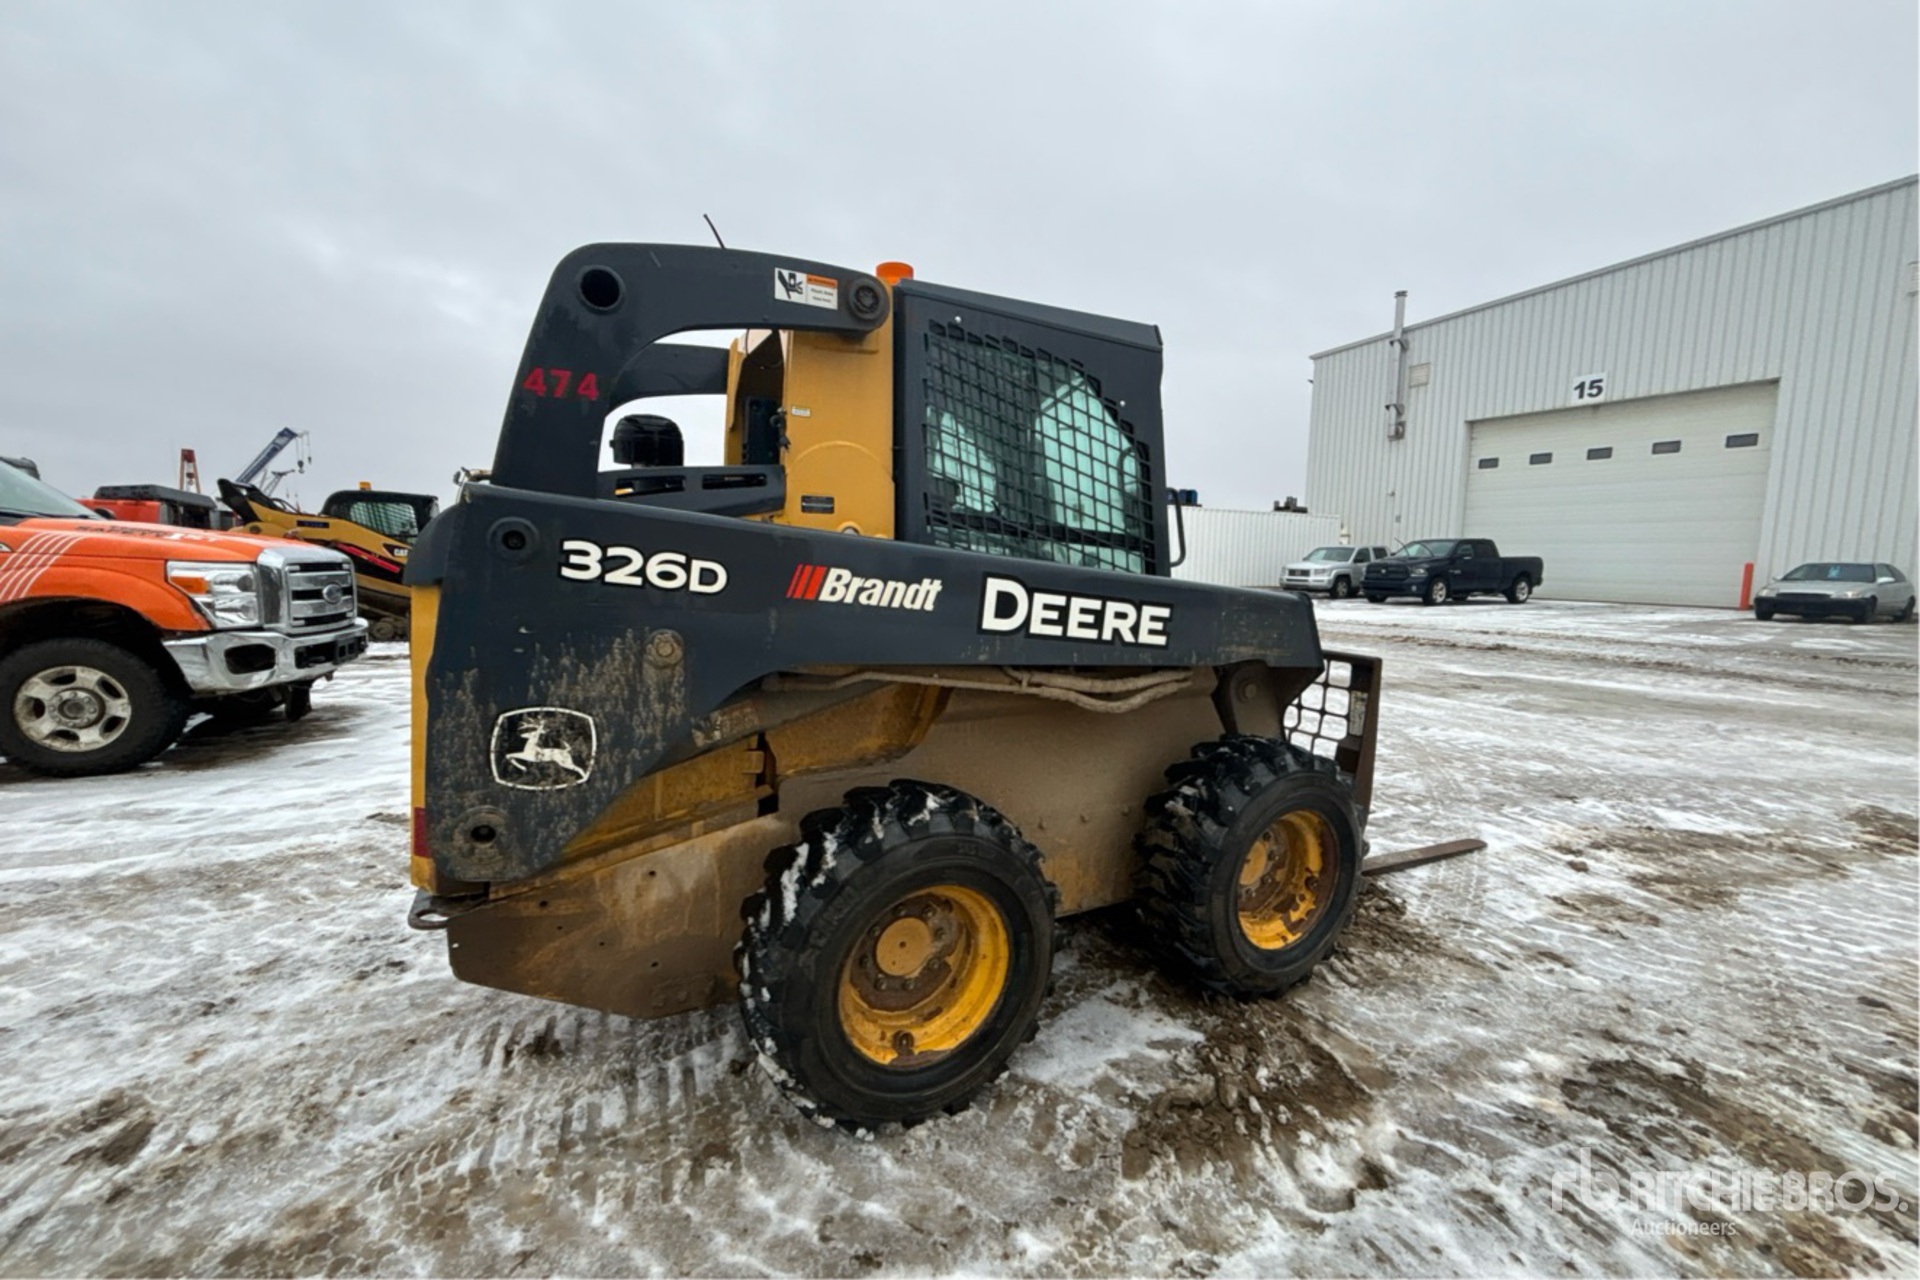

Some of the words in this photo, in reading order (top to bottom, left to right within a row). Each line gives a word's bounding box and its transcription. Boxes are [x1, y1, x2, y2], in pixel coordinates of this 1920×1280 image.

[523, 367, 599, 401] 474
[1574, 378, 1604, 400] 15
[560, 540, 728, 593] 326D
[818, 567, 942, 612] Brandt
[981, 577, 1171, 646] DEERE
